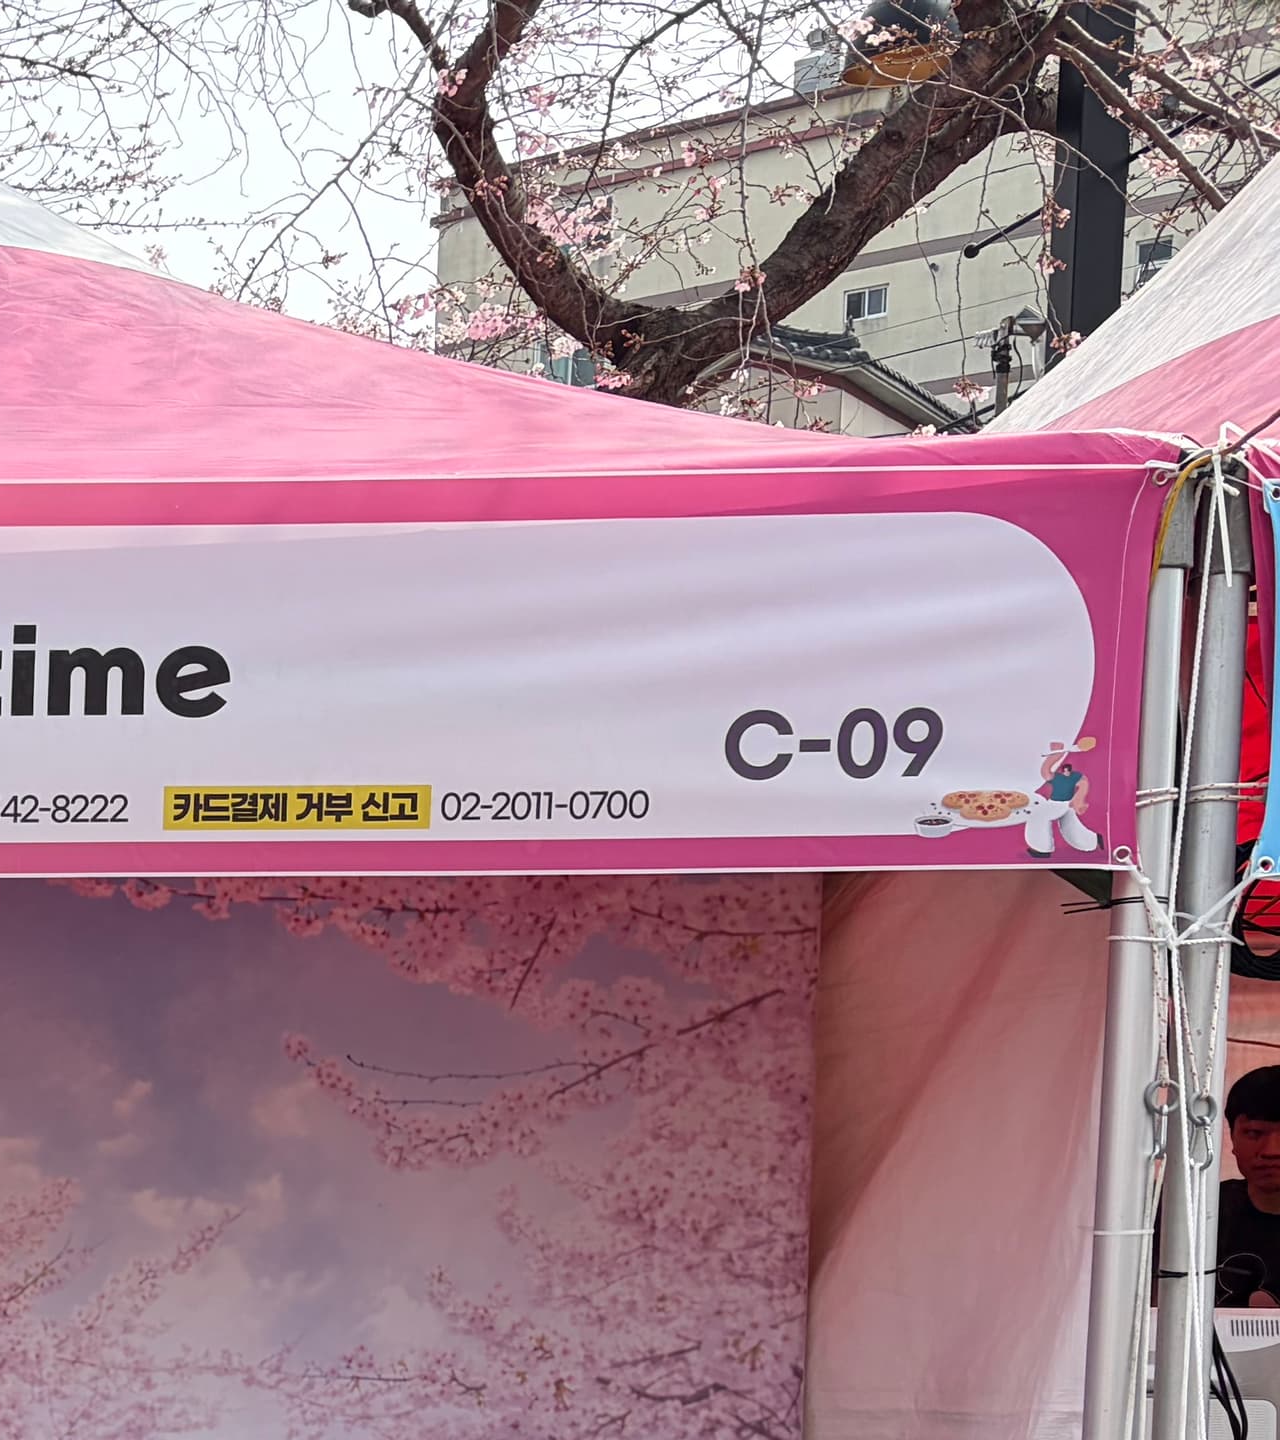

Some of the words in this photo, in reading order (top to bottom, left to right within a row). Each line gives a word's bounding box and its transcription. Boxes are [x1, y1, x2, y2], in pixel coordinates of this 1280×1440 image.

[724, 706, 944, 780] C-09
[173, 793, 288, 822] 카드결제
[295, 792, 354, 822] 거부
[361, 792, 419, 822] 신고
[441, 790, 649, 820] 02-2011-0700
